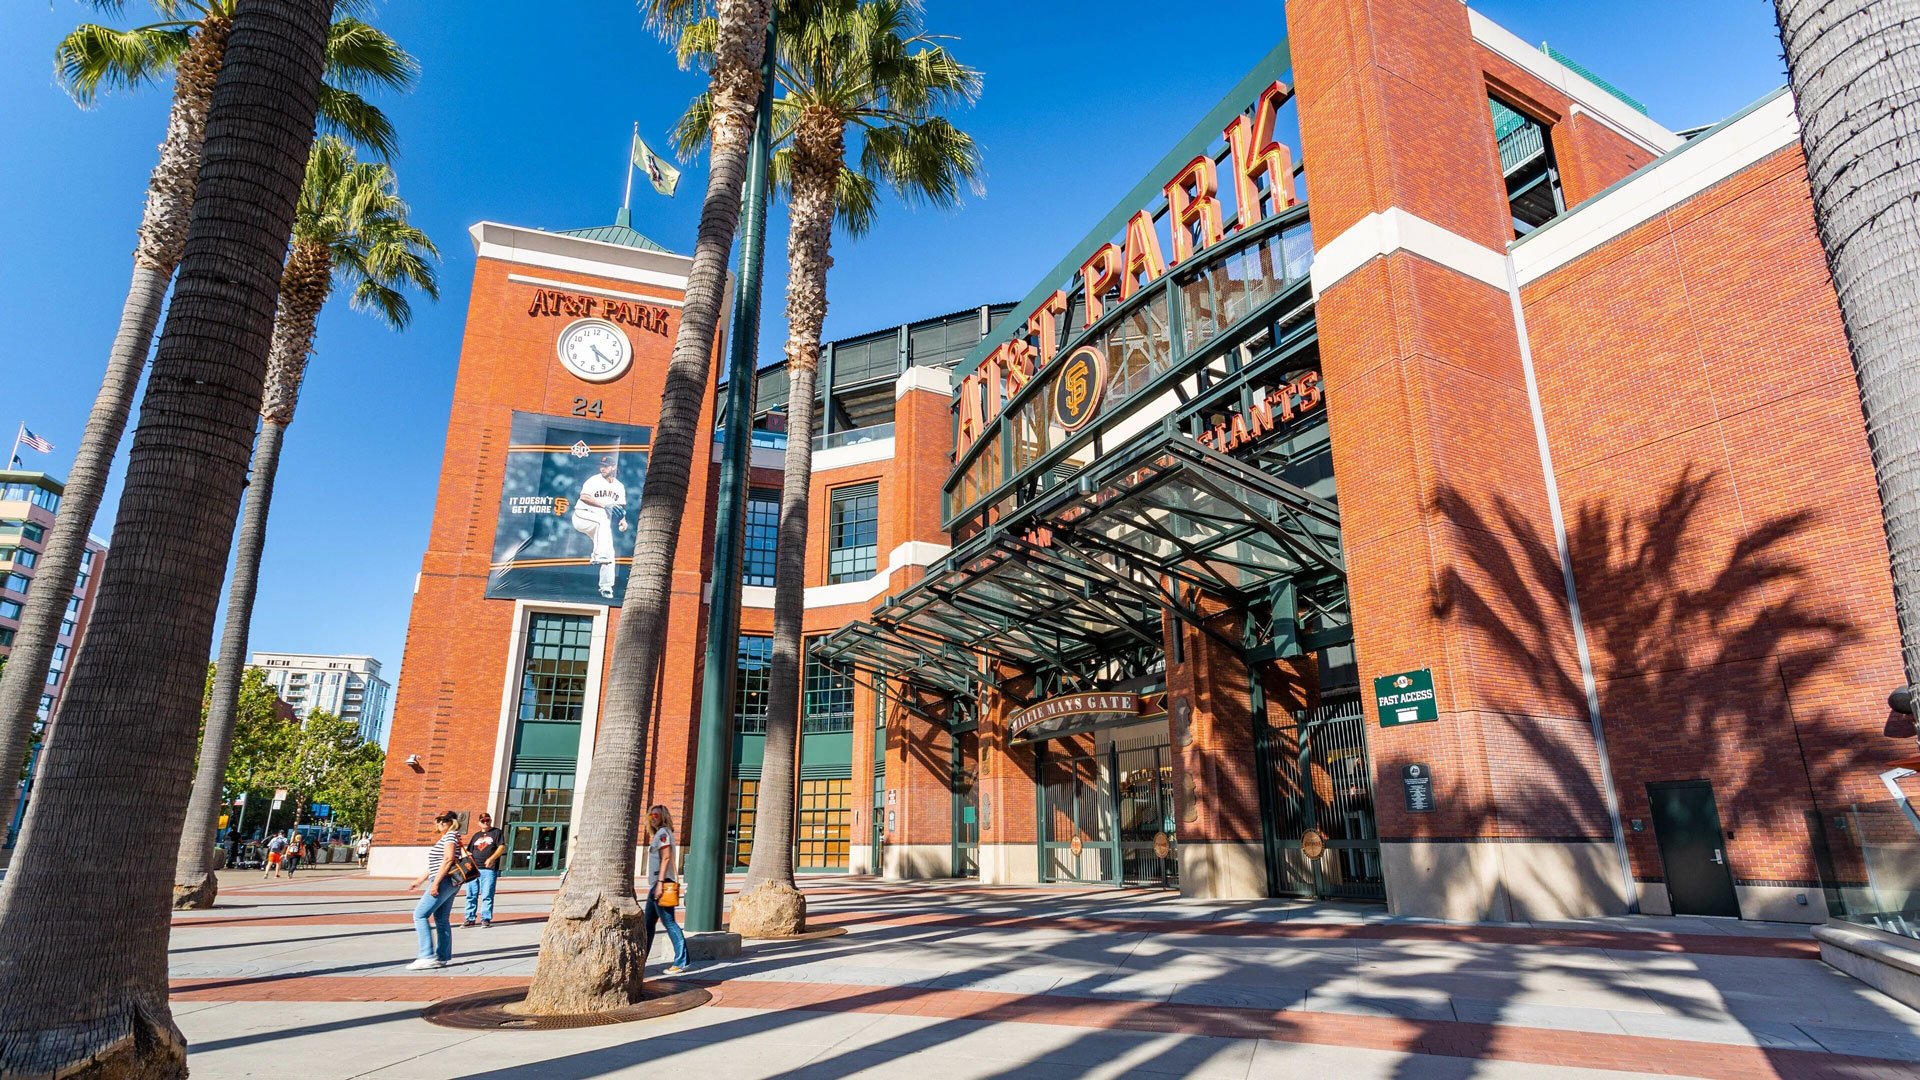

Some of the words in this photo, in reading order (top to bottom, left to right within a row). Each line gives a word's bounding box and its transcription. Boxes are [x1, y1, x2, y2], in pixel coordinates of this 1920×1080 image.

[955, 290, 1066, 465] AT&T
[1080, 80, 1296, 330] PARK
[528, 289, 597, 317] AT&T
[602, 300, 669, 338] PARK
[572, 397, 603, 418] 24
[509, 497, 518, 505] IT
[519, 496, 553, 504] DOESN'T
[594, 490, 619, 501] GIANTS
[512, 506, 528, 514] GET
[528, 505, 552, 514] MORE
[1378, 694, 1399, 706] FAST
[1400, 689, 1433, 703] ACCESS
[1011, 706, 1044, 733] WILLIE
[1046, 698, 1082, 715] MAYS
[1088, 696, 1132, 709] GATE
